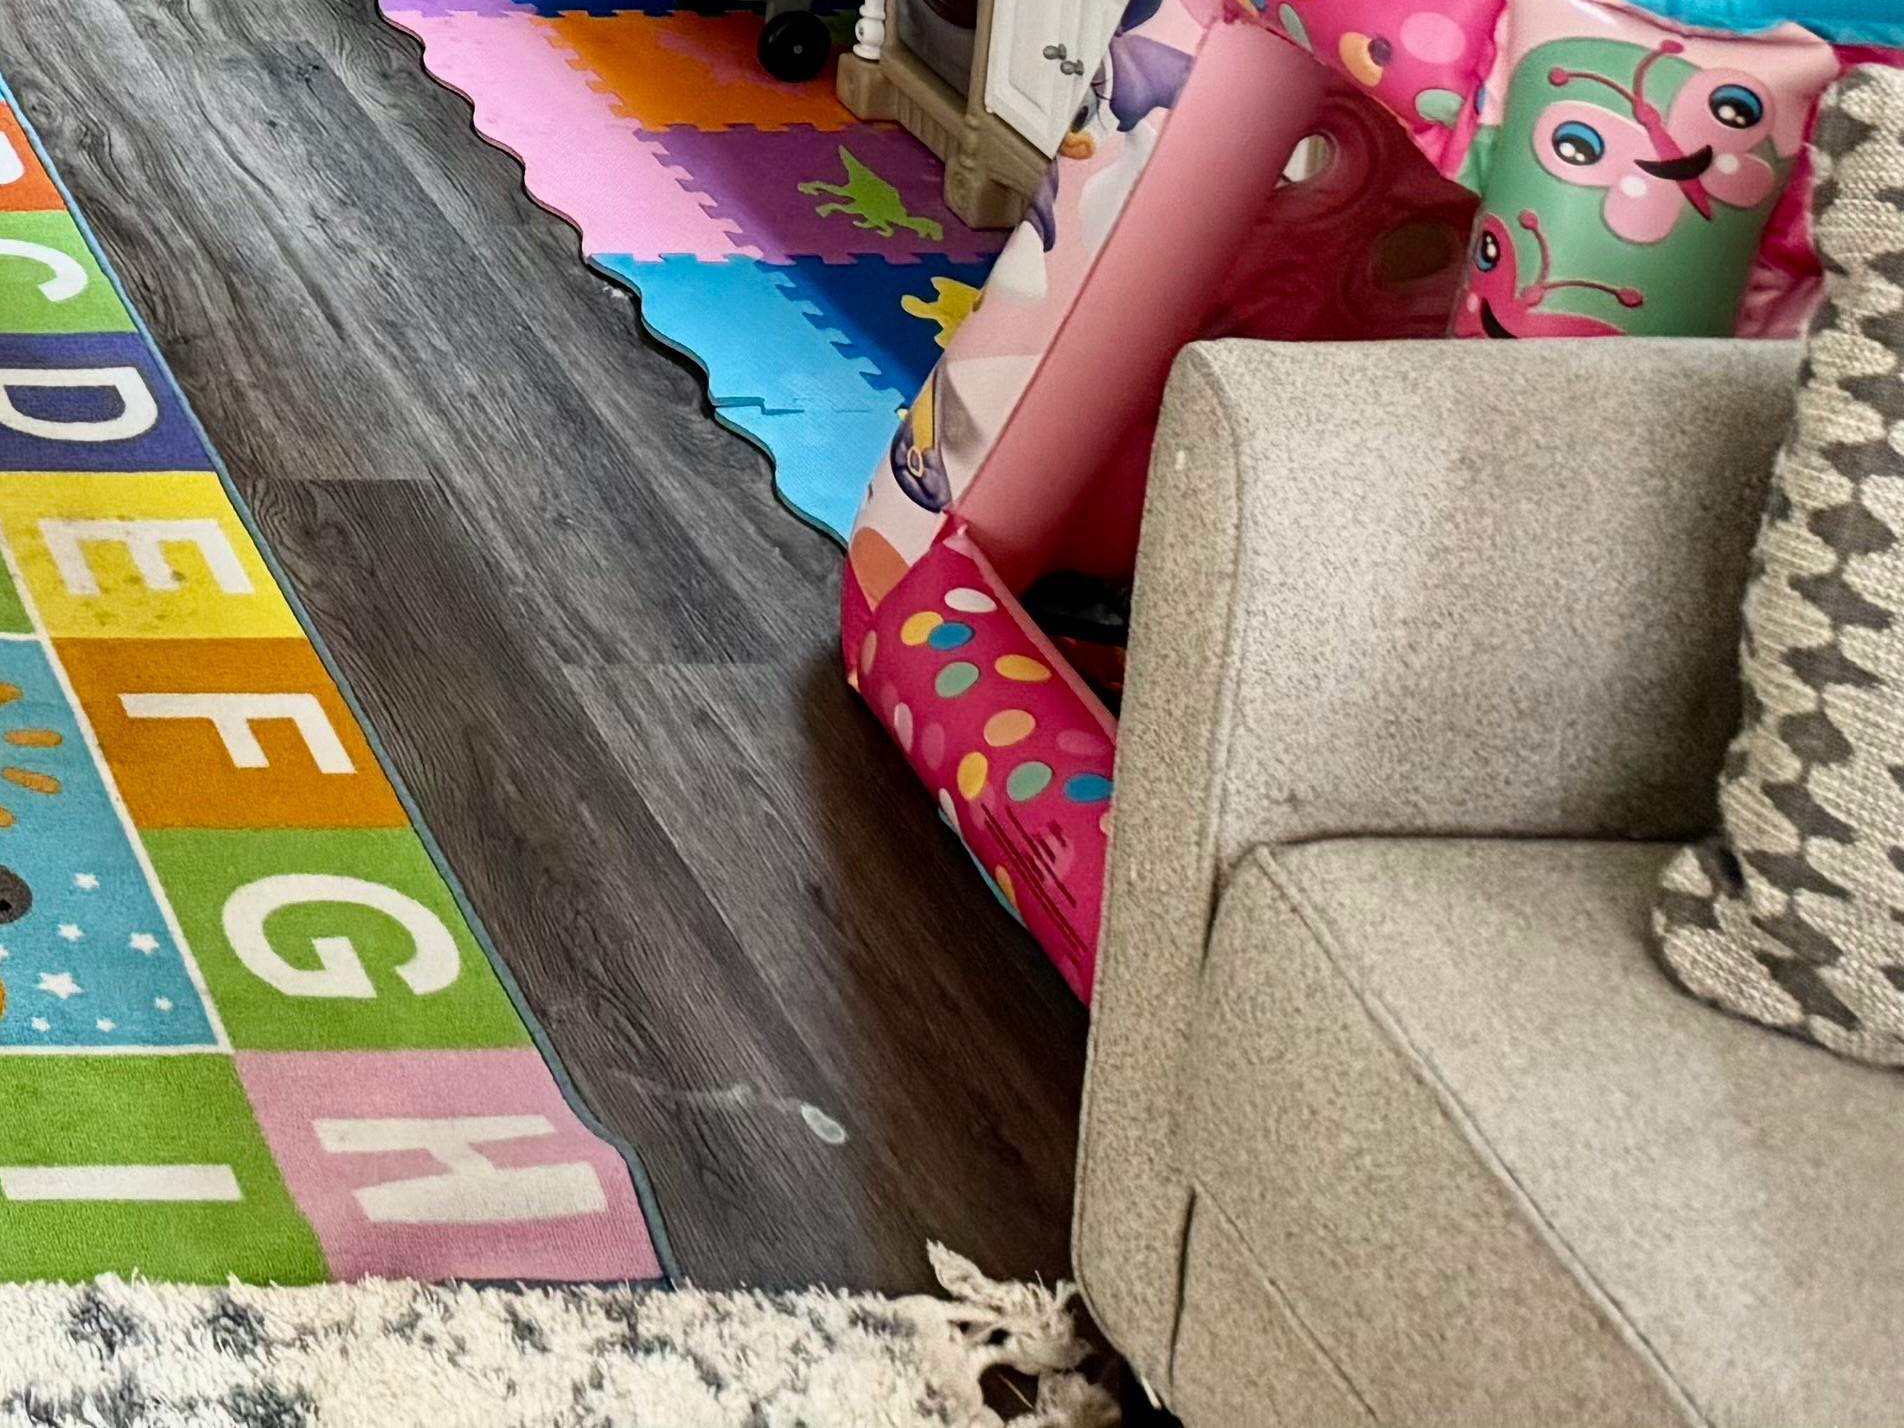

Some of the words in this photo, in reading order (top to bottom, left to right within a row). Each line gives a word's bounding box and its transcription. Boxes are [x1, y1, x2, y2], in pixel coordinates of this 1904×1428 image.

[35, 515, 258, 598] E
[118, 692, 356, 776] F
[221, 871, 462, 1000] G
[2, 1162, 242, 1203] I
[312, 1112, 609, 1226] H
